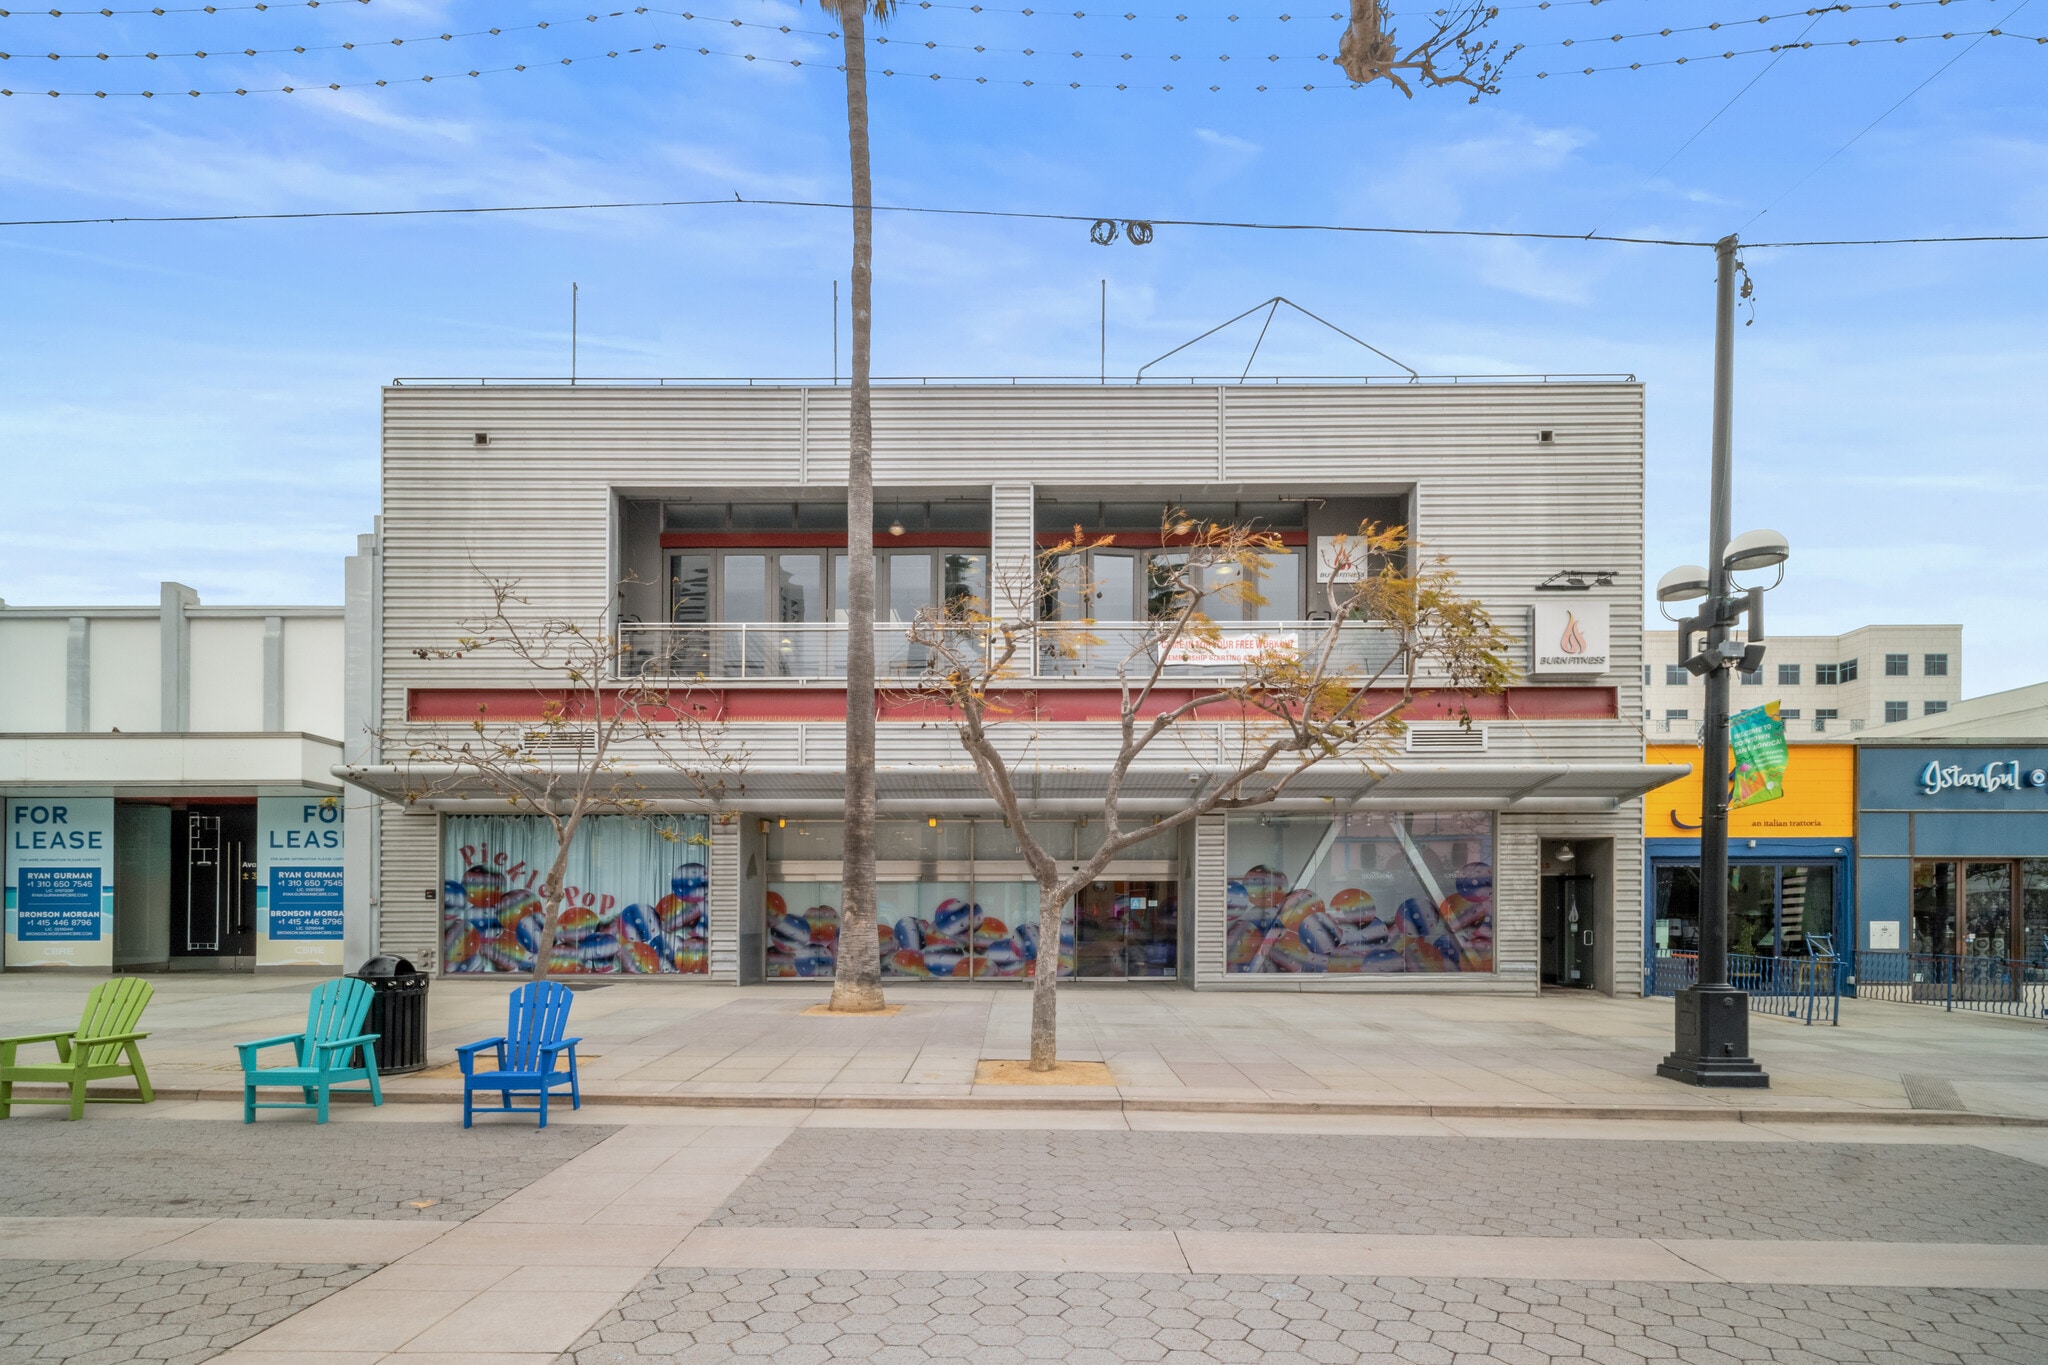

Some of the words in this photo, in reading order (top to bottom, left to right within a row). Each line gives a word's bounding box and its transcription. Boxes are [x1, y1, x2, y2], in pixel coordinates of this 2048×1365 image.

[1162, 640, 1184, 648] CME
[1236, 640, 1254, 648] FREE
[1924, 760, 2022, 794] Istanbul
[15, 806, 68, 824] FOR
[16, 831, 102, 850] LEASE
[270, 830, 344, 848] LEAS
[564, 885, 616, 916] Pop
